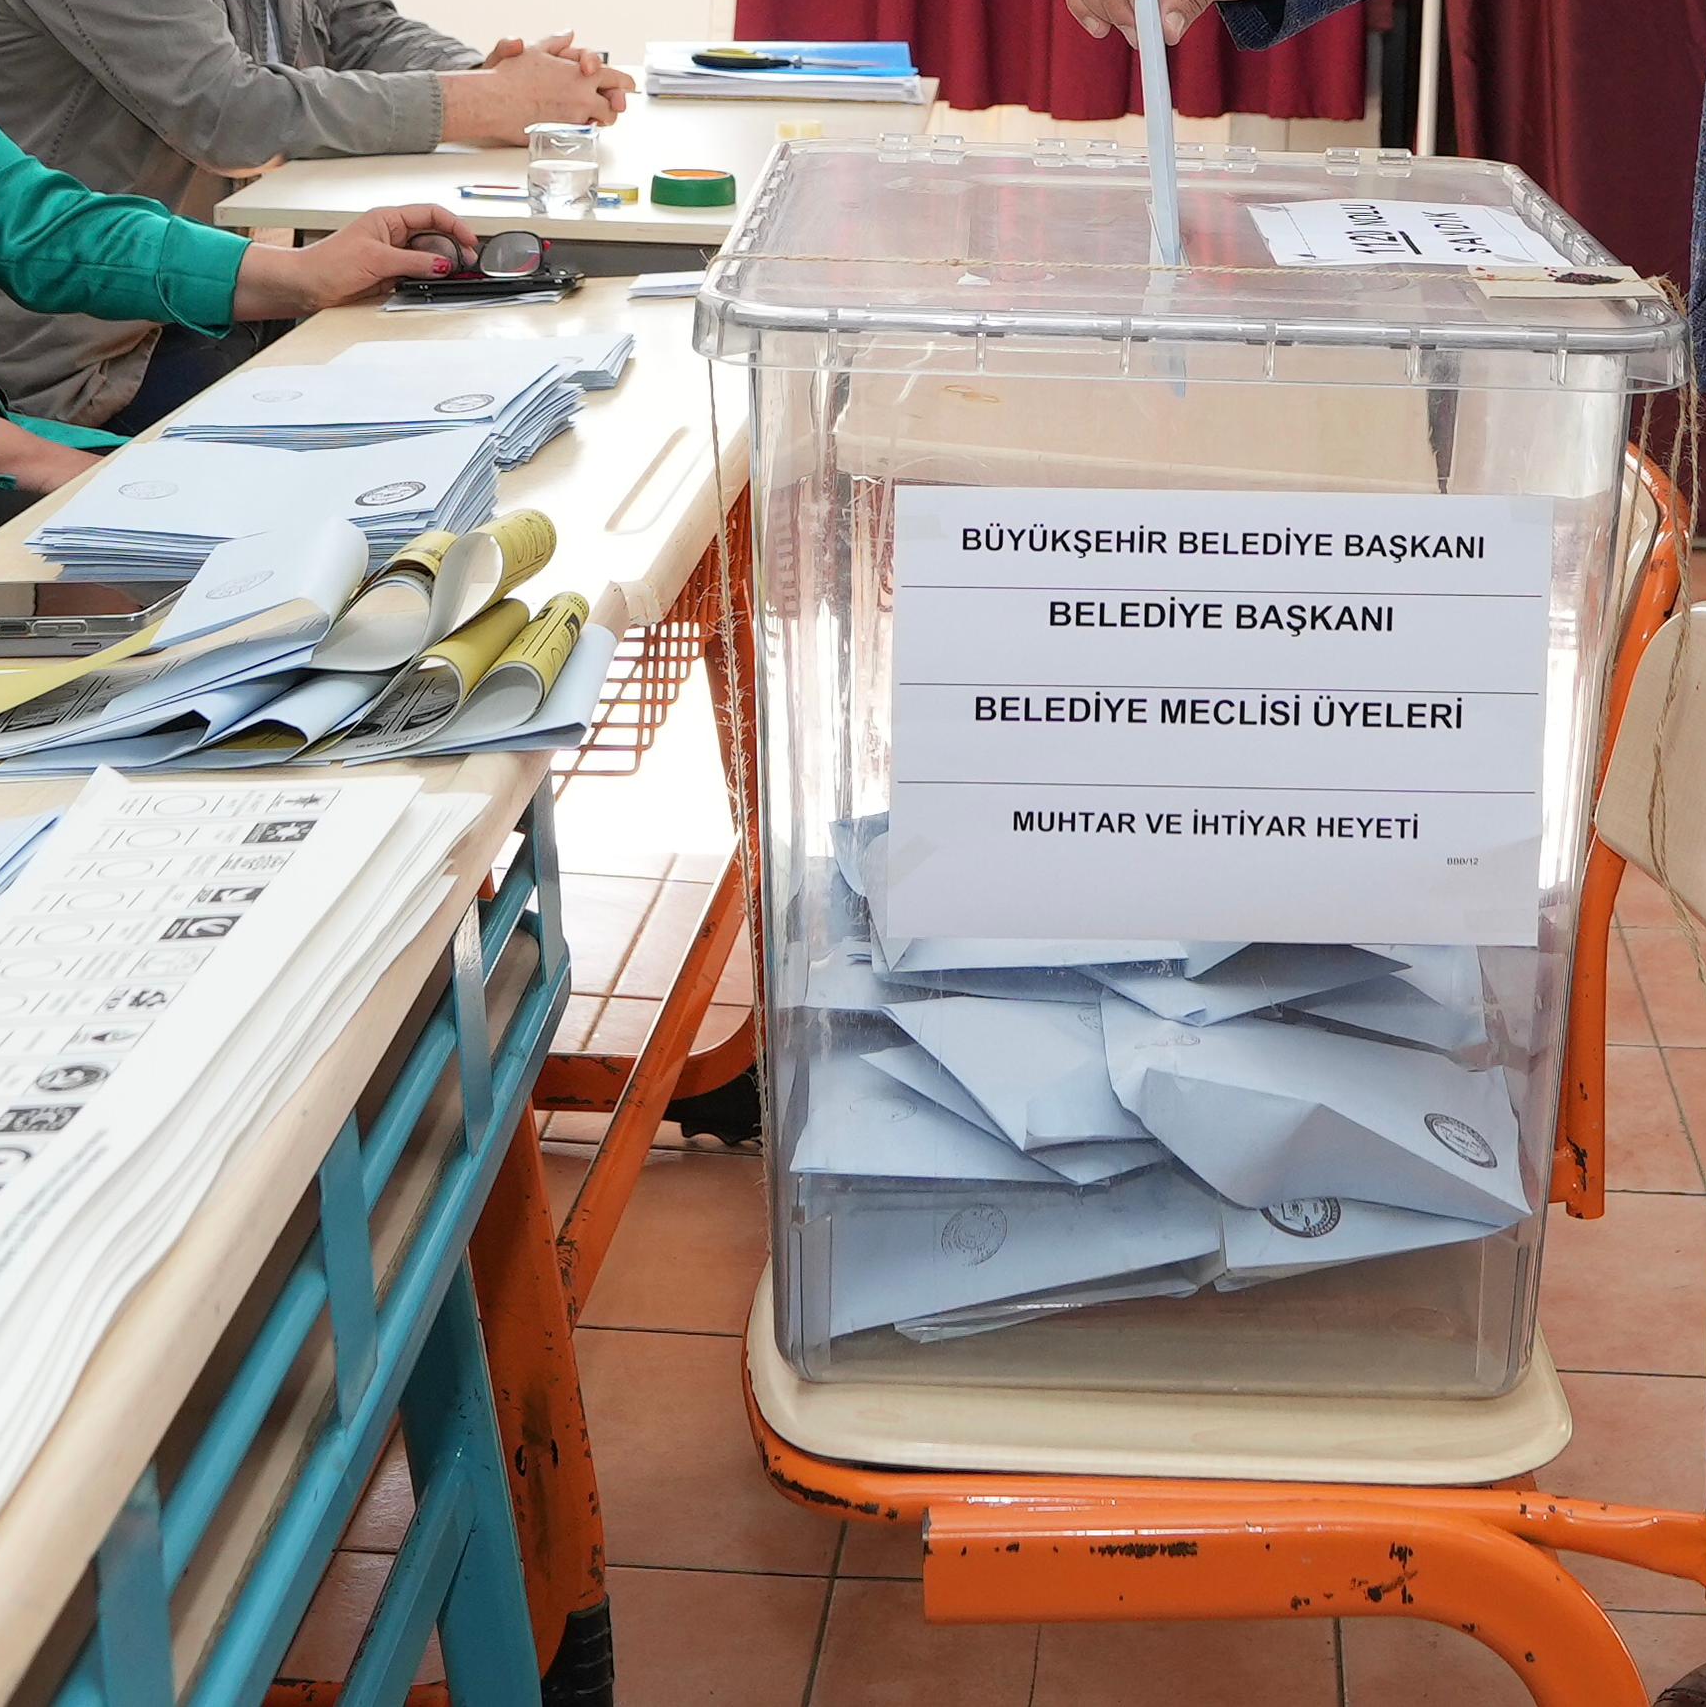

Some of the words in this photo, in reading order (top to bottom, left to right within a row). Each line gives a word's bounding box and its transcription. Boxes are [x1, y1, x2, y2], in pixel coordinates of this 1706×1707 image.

[1339, 203, 1390, 227] NOLU
[1421, 210, 1492, 255] SANDIK
[962, 522, 1167, 561] BÜYÜKŞEHİR
[1178, 527, 1333, 558] BELEDİYE
[1344, 533, 1484, 565] BAŞKANI
[1049, 596, 1223, 630] BELEDİYE
[1236, 604, 1394, 638] BAŞKANI
[974, 692, 1149, 725] BELEDİYE
[1160, 694, 1301, 727] MECLİSİ
[1313, 695, 1464, 730] ÜYELERİ
[1013, 810, 1137, 835] MUHTAR
[1145, 812, 1183, 835] VE
[1193, 808, 1306, 838] İHTİYAR
[1316, 811, 1419, 840] HEYETİ
